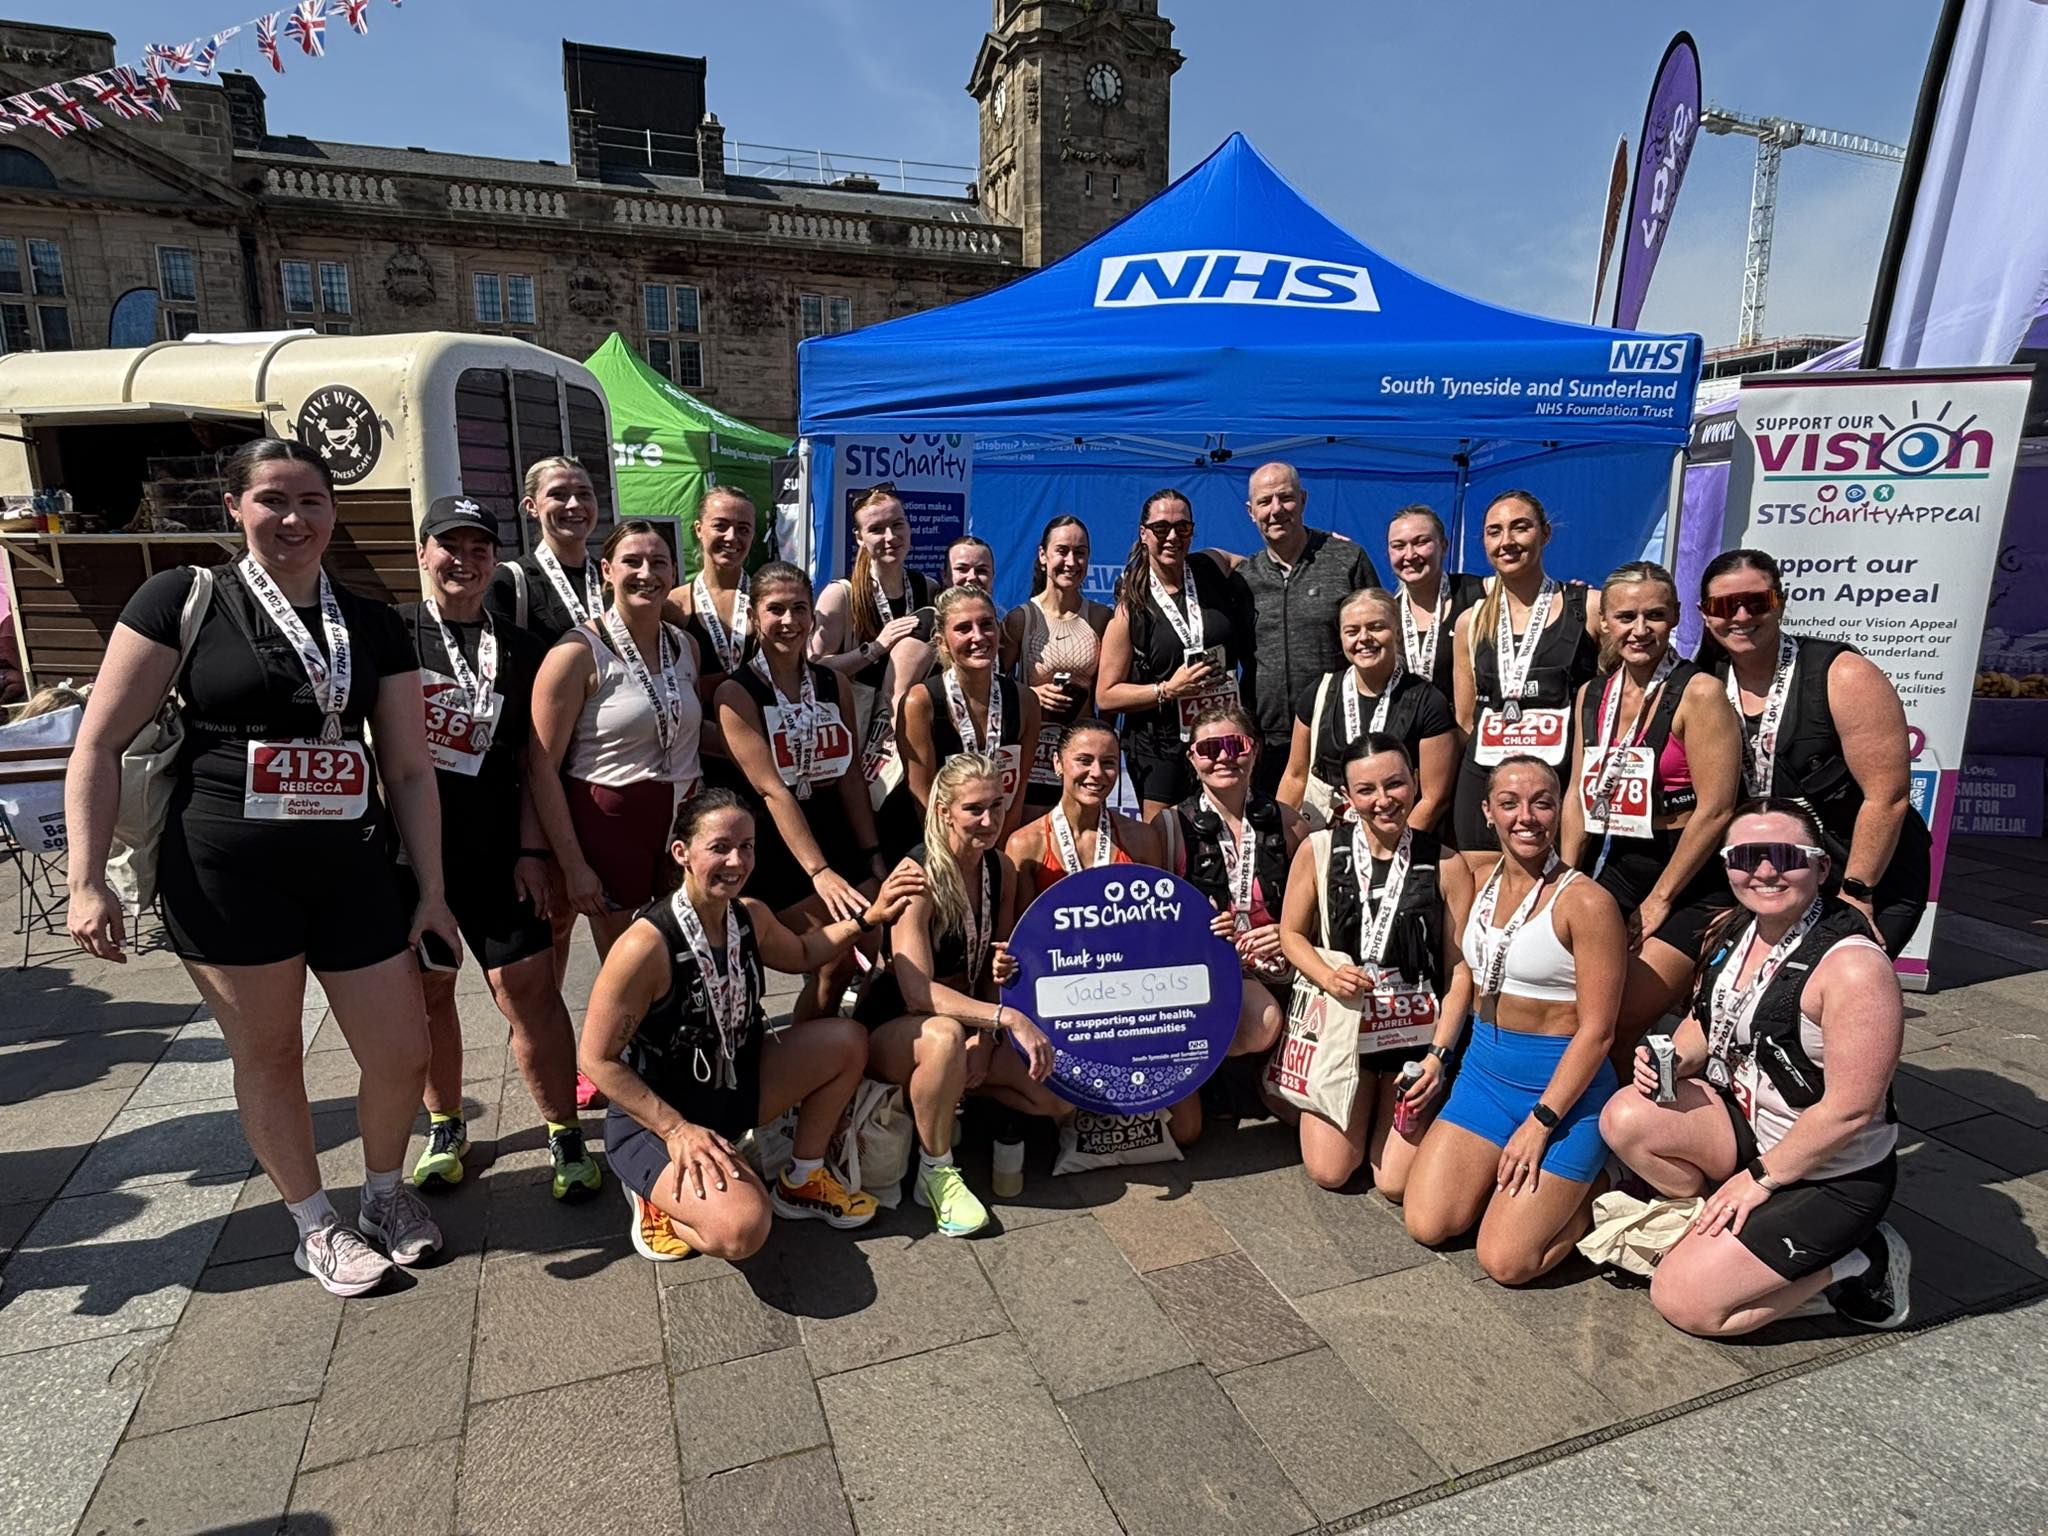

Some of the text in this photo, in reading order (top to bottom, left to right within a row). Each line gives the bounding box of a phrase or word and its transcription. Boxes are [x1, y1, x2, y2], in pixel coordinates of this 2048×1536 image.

[1103, 254, 1359, 305] NHS
[1611, 342, 1684, 370] NHS
[1381, 376, 1678, 400] South Tyneside and Sunderland
[303, 391, 368, 424] LIVE WELL
[1535, 403, 1674, 418] NHS Foundation Trust
[1756, 415, 1874, 431] SUPPORT OUR
[330, 469, 356, 479] TNESS
[928, 502, 947, 511] make
[919, 515, 931, 523] our
[911, 526, 921, 534] nd
[1774, 555, 1919, 577] pport our
[263, 589, 286, 614] 2025
[1834, 583, 1940, 607] Appeal
[1839, 618, 1862, 628] our
[1865, 618, 1906, 628] Vision
[1909, 619, 1958, 631] Appeal
[1855, 633, 1869, 643] to
[1872, 633, 1924, 645] support
[1928, 635, 1952, 644] our
[327, 602, 346, 709] 10K FINISHER 2025
[1513, 664, 1523, 682] 10K
[1521, 620, 1541, 657] FINISHER
[623, 644, 639, 663] 10K
[636, 670, 664, 713] FINISHER
[1768, 645, 1793, 722] 10K FINISHER
[1896, 671, 1911, 681] us
[1914, 670, 1944, 681] fund
[1895, 683, 1946, 695] facilities
[426, 706, 469, 736] 36
[784, 713, 797, 731] 10K
[1487, 713, 1558, 736] 5220
[426, 732, 453, 746] ATIE
[1502, 736, 1537, 745] CHLOE
[266, 750, 356, 780] 4132
[279, 781, 343, 793] REBECCA
[1585, 779, 1644, 804] 478
[1602, 776, 1616, 795] 10K
[288, 799, 320, 807] Active
[288, 807, 344, 816] Sunderland
[1608, 803, 1623, 813] EX
[1975, 800, 2000, 815] FOR
[1972, 816, 2027, 832] AMELIA!
[1060, 831, 1071, 847] 10K
[1240, 862, 1250, 905] FINISHER
[1379, 905, 1391, 930] 2025
[1780, 929, 1801, 949] 10K
[1047, 948, 1124, 972] Thank you
[1487, 945, 1506, 993] FINISHER
[1064, 972, 1189, 1009] Jade's Gals
[1362, 994, 1430, 1021] 4583
[1054, 1008, 1197, 1030] For supporting our health,
[1371, 1018, 1414, 1031] FARRELL
[1067, 1023, 1187, 1042] care and communities
[1189, 1040, 1208, 1049] NHS
[1275, 1071, 1300, 1090] 2025
[1091, 1121, 1155, 1146] RED SKY
[1094, 1135, 1159, 1153] FOUNDATION
